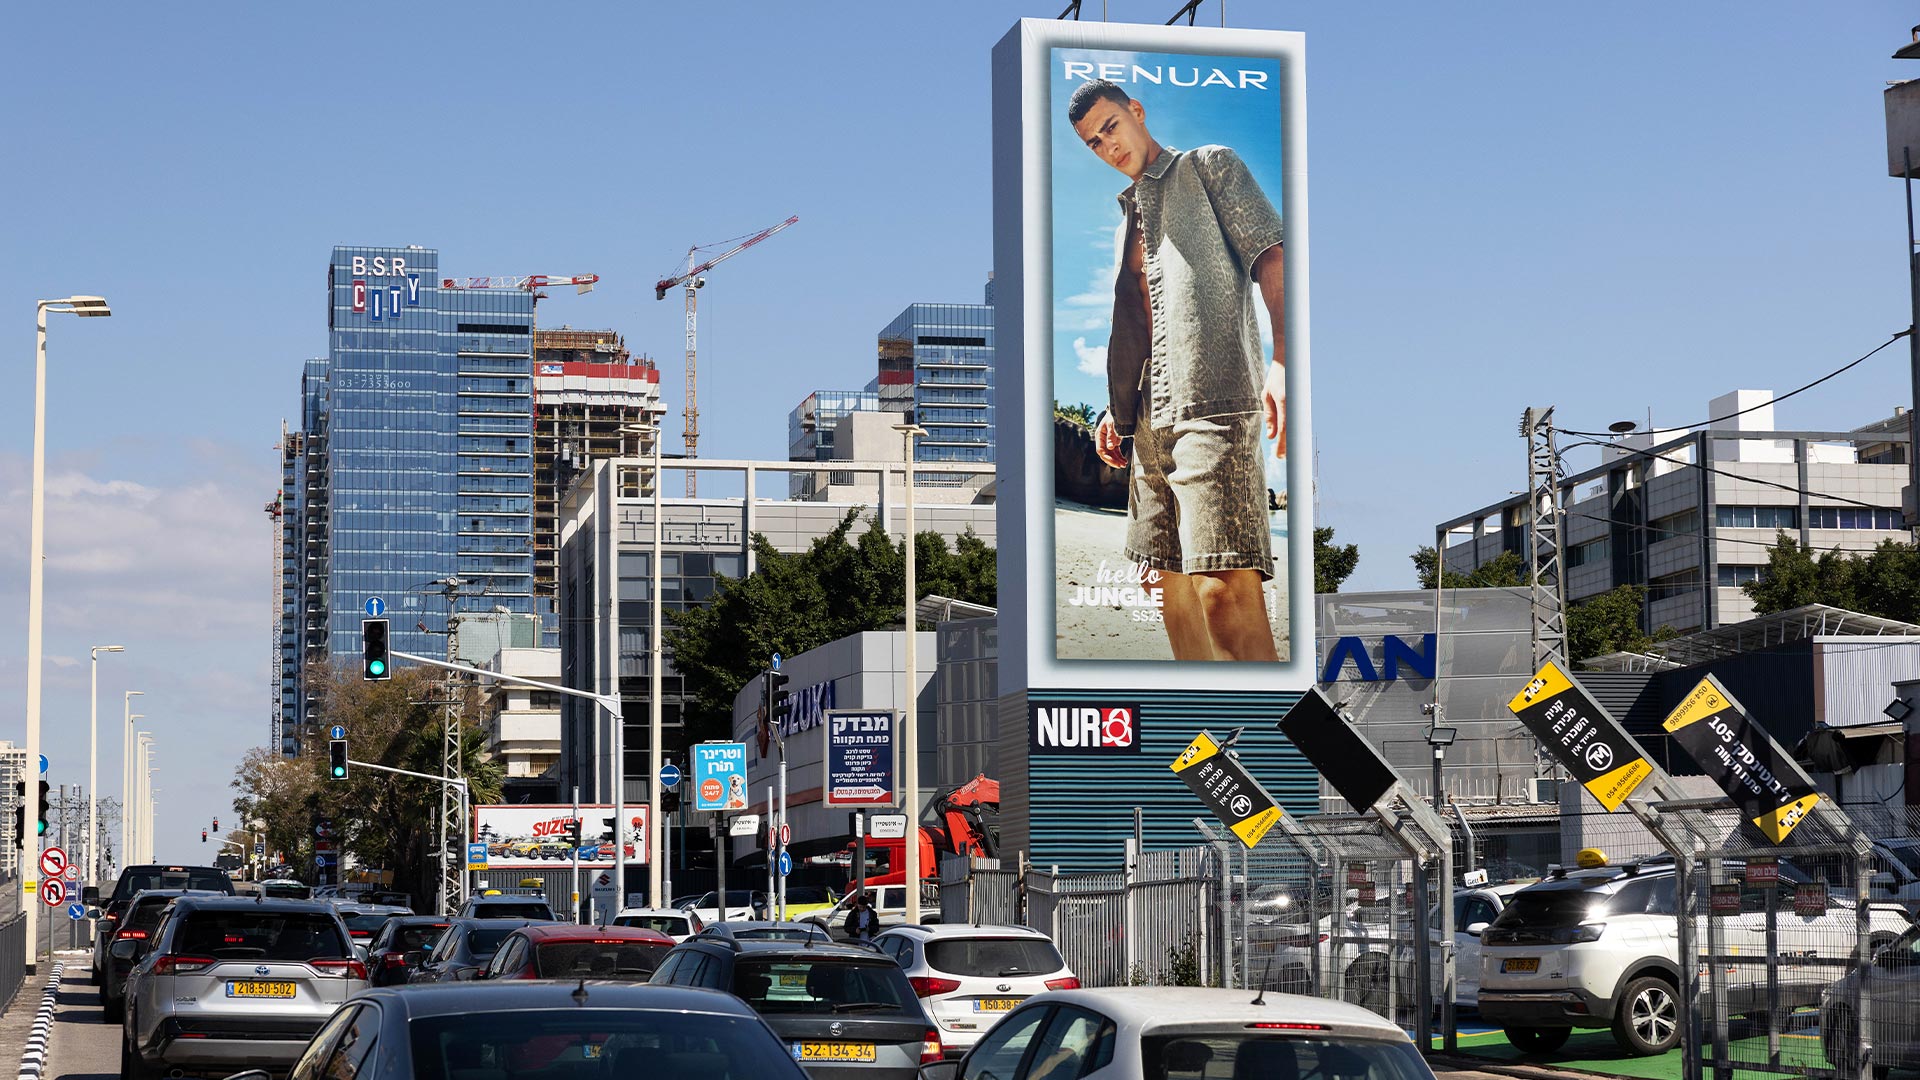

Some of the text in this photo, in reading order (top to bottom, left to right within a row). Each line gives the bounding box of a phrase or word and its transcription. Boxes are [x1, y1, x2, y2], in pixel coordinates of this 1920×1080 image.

[1064, 61, 1268, 90] RENUAR
[352, 256, 406, 277] B.S.R
[353, 275, 420, 320] CITY
[340, 379, 411, 389] 03-7353600
[1096, 560, 1163, 584] hello
[1069, 586, 1163, 607] JUNGLE
[1132, 610, 1163, 622] SS25
[1523, 678, 1546, 700] TAXI
[1544, 699, 1564, 720] קניה
[1670, 685, 1708, 726] 054-9566686
[833, 716, 889, 735] מבדק
[1552, 707, 1577, 734] מכירה
[1561, 716, 1589, 746] השכרה
[1708, 715, 1736, 743] 105
[833, 735, 890, 745] פתח תקווה
[1571, 727, 1598, 757] טרייד אין
[700, 749, 742, 760] וטרינר
[1198, 762, 1214, 779] קניה
[1204, 768, 1224, 789] מכירה
[1606, 762, 1641, 799] 054-9566686
[1714, 744, 1762, 796] פתח תקווה
[1211, 774, 1234, 799] השכרה
[532, 816, 583, 837] SUZUI
[1467, 877, 1480, 886] Gett
